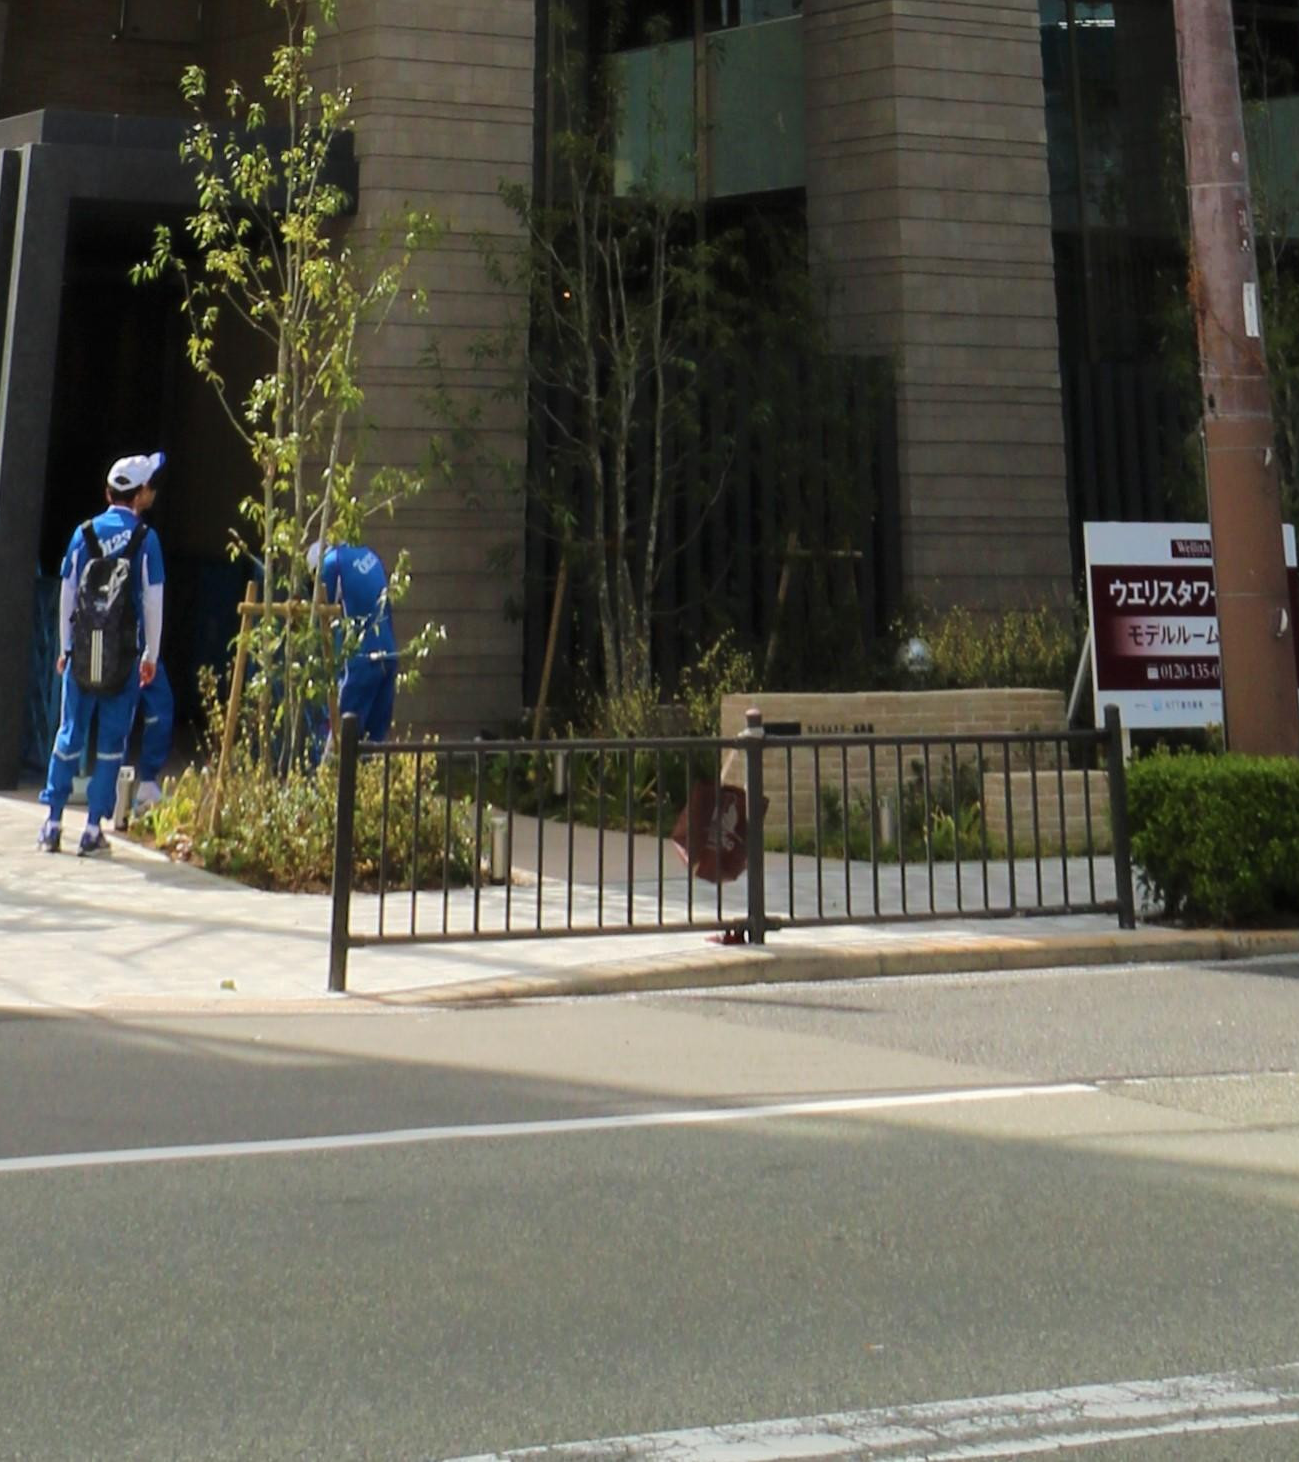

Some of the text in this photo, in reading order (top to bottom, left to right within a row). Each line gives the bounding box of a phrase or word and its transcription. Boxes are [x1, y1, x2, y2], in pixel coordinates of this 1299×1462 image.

[1108, 578, 1216, 607] ウエリスタワ
[1128, 624, 1220, 647] モデルルーム
